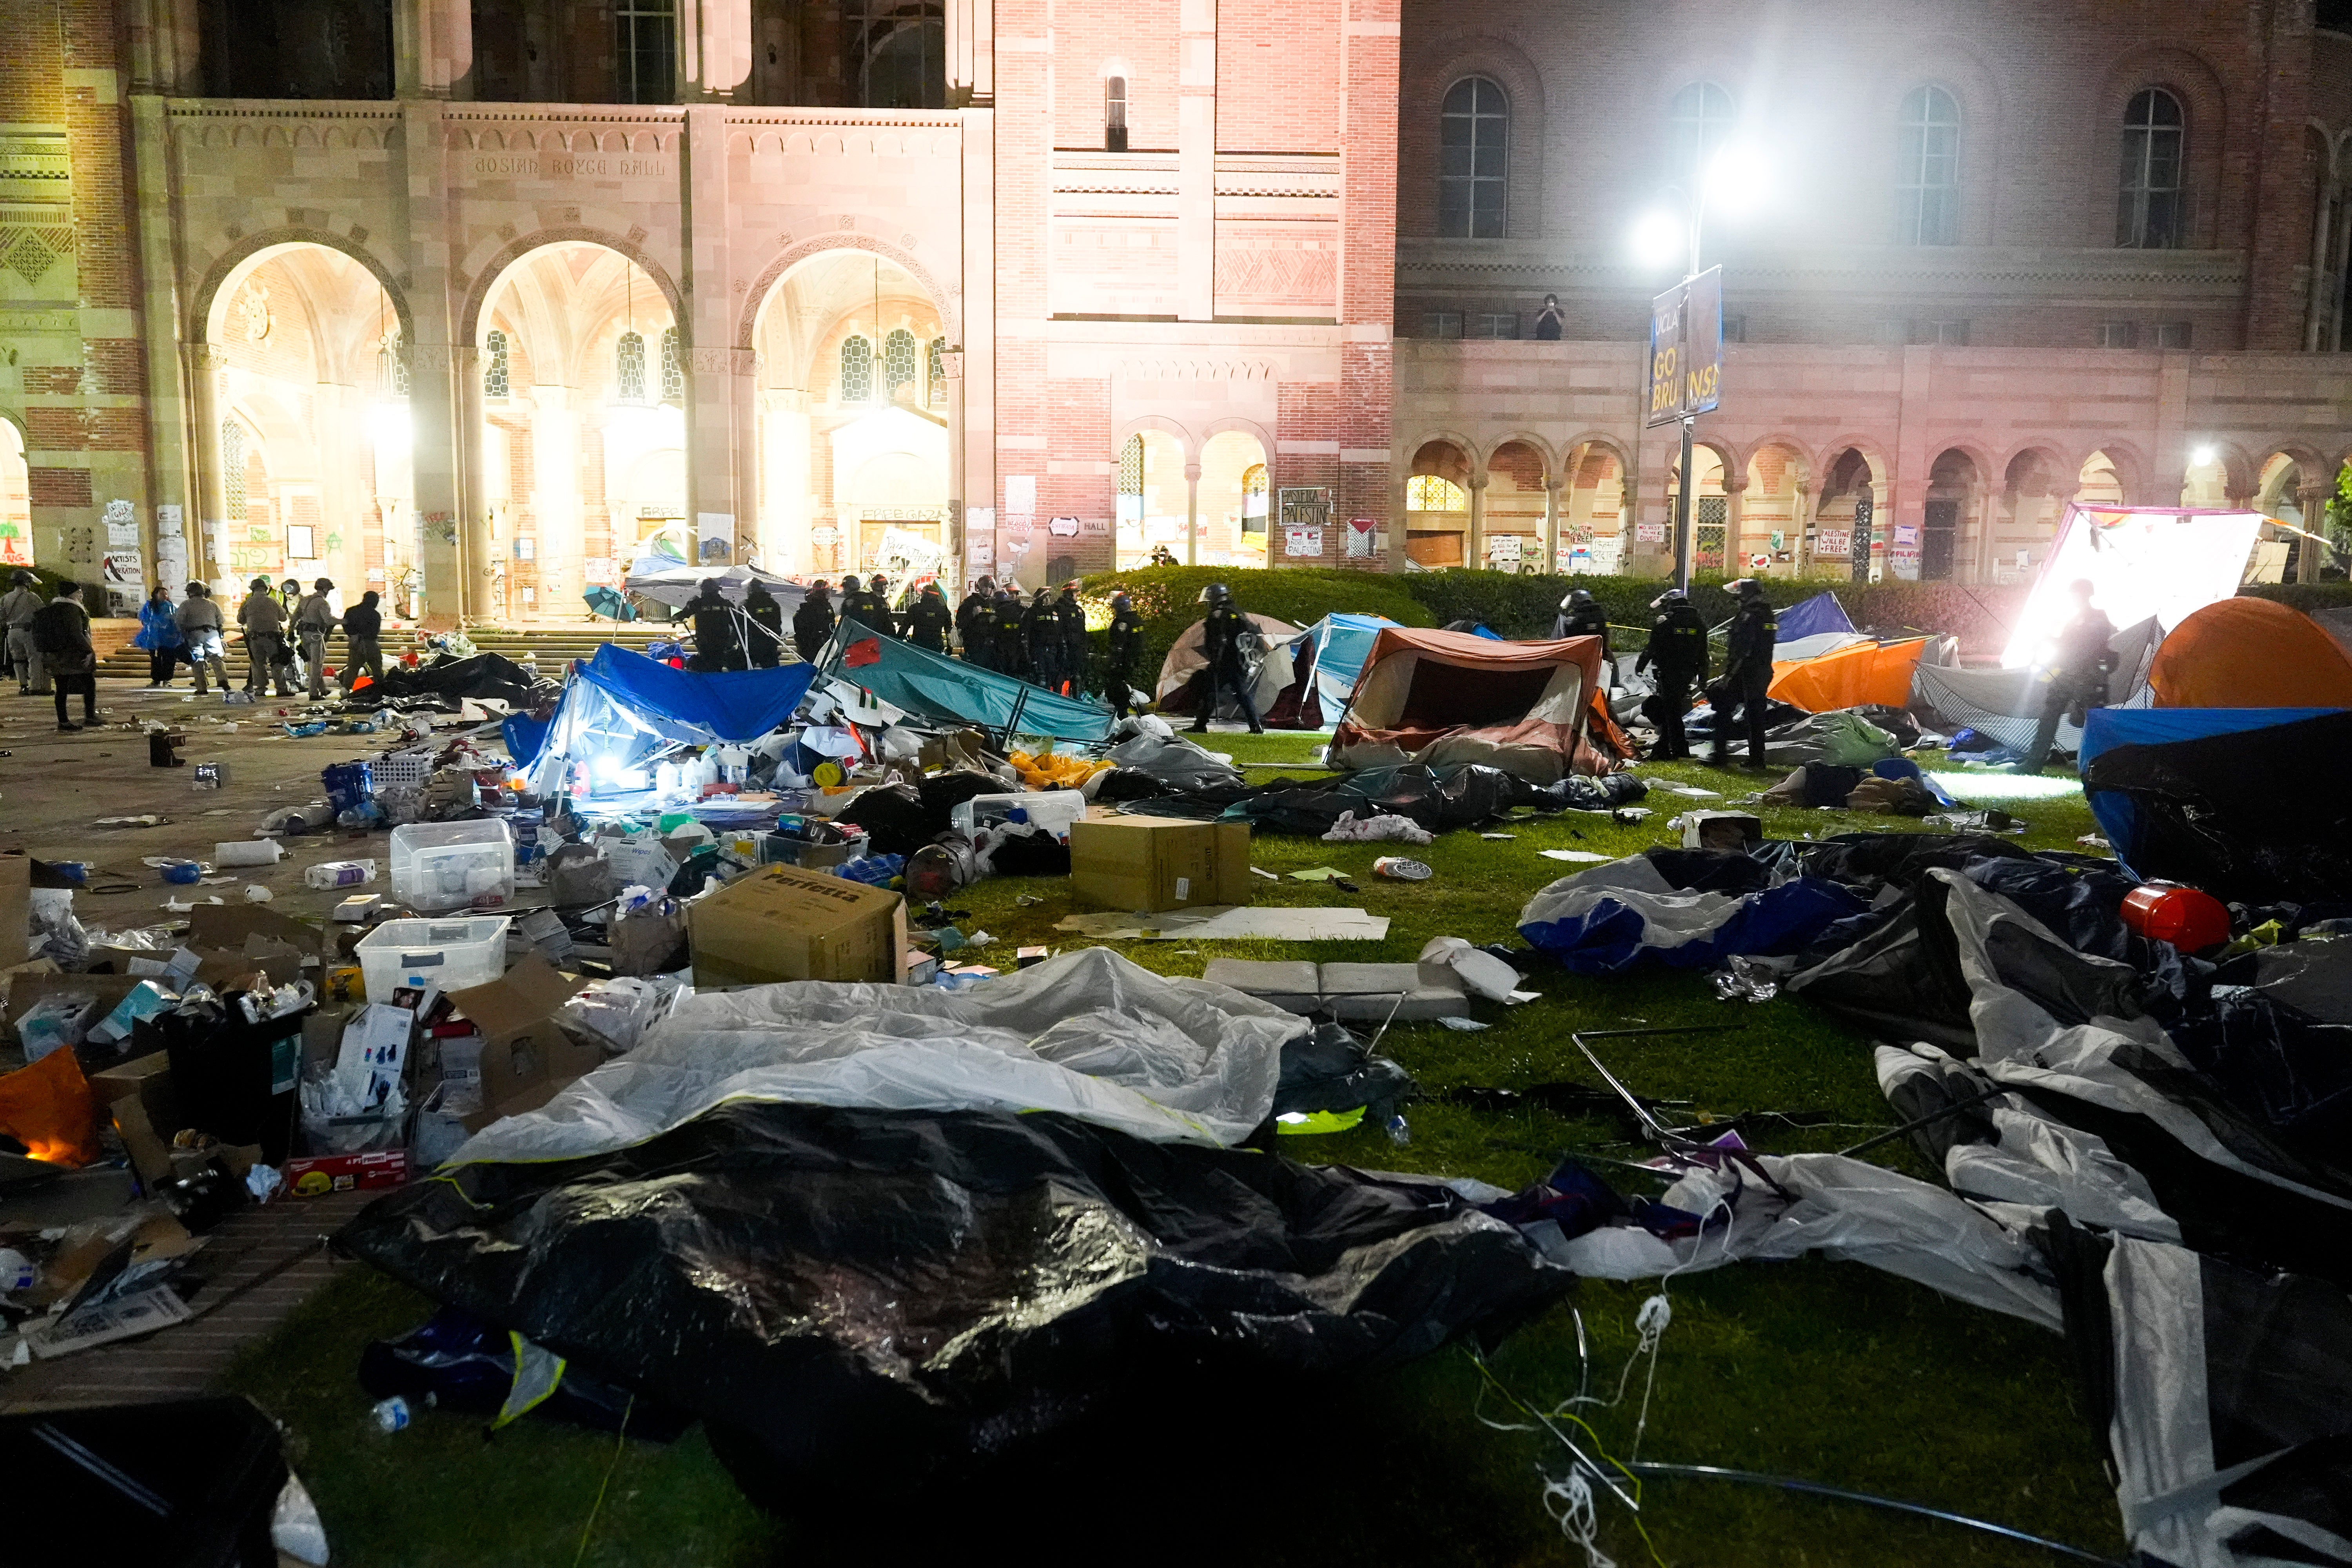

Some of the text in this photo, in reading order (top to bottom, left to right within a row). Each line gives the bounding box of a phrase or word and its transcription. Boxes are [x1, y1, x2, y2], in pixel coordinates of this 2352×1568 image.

[1655, 309, 1678, 336] UCLA
[1654, 347, 1676, 380] GO
[1652, 377, 1677, 412] BRU
[1319, 488, 1329, 502] 4
[863, 509, 947, 521] FREE GAZA
[1282, 506, 1330, 524] PALESTINE
[1288, 546, 1322, 555] PALESTINE
[762, 874, 860, 903] Perfetta
